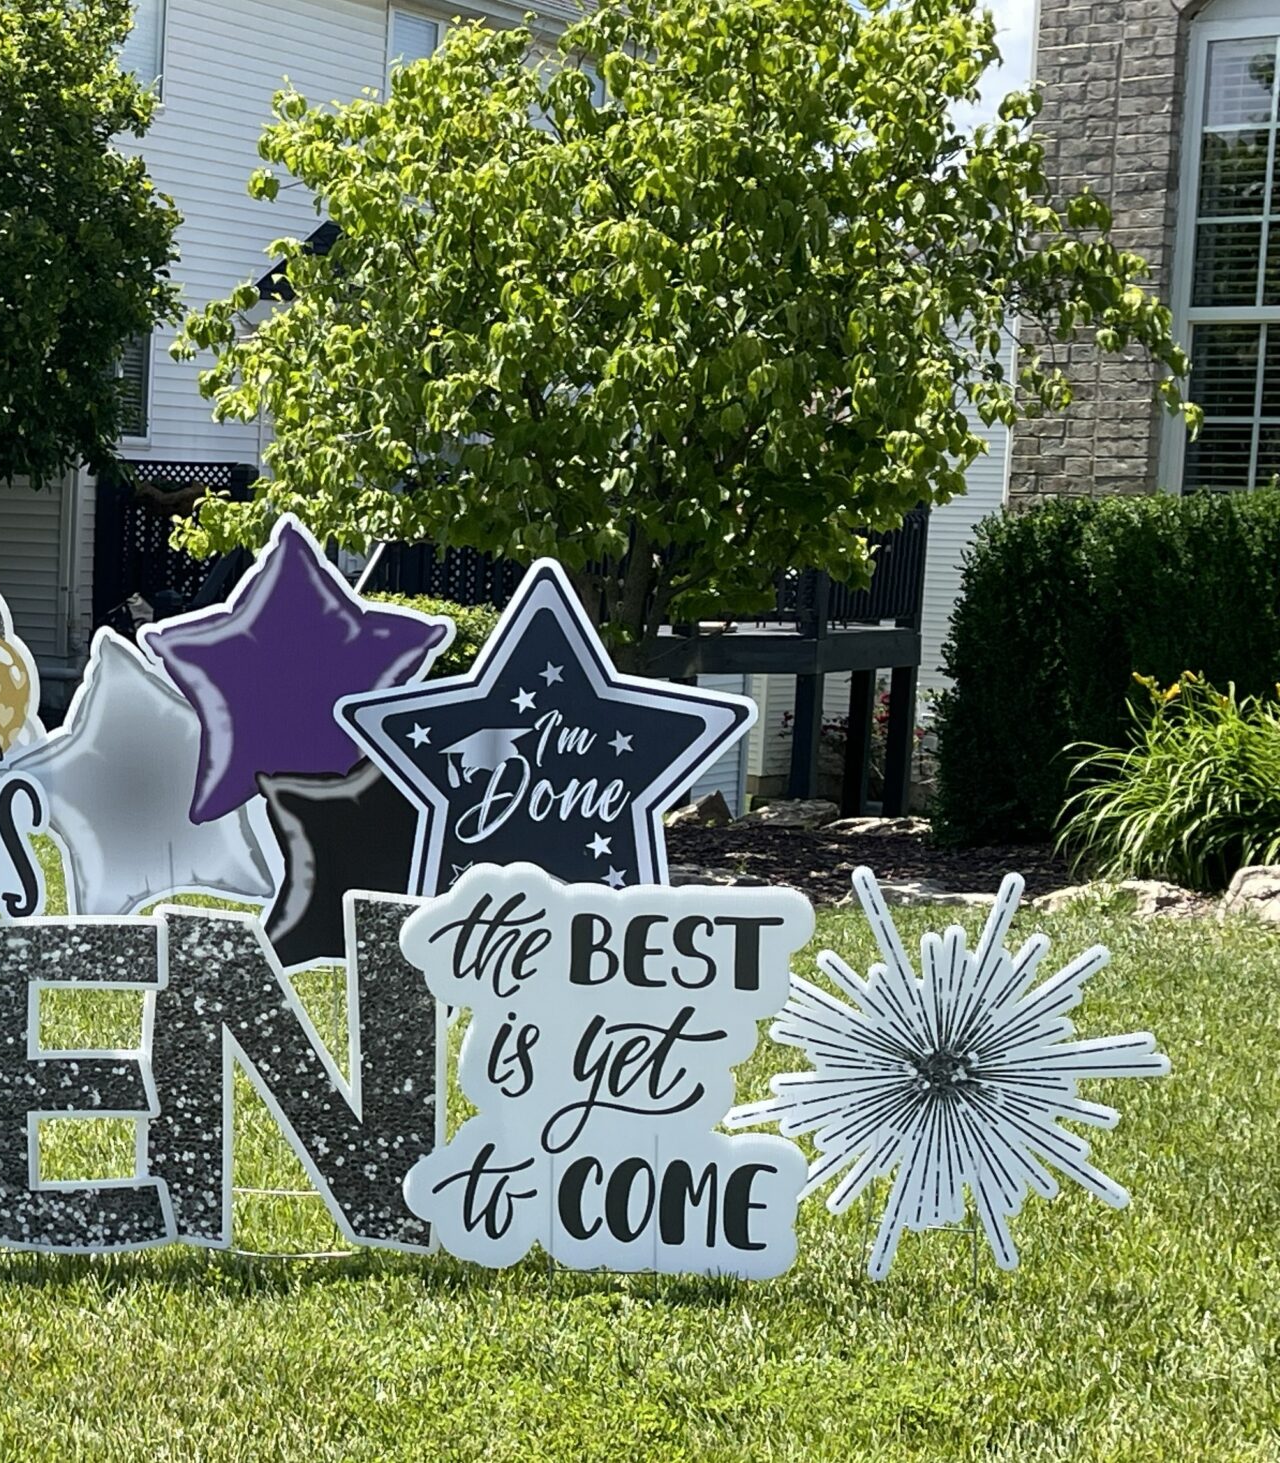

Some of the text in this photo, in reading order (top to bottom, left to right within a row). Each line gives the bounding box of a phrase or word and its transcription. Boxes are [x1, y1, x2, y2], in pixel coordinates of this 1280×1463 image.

[533, 709, 599, 768] I'm
[454, 754, 632, 845] Done
[428, 892, 784, 998] the BEST
[487, 1006, 728, 1154] is yet
[431, 1142, 779, 1251] to COME
